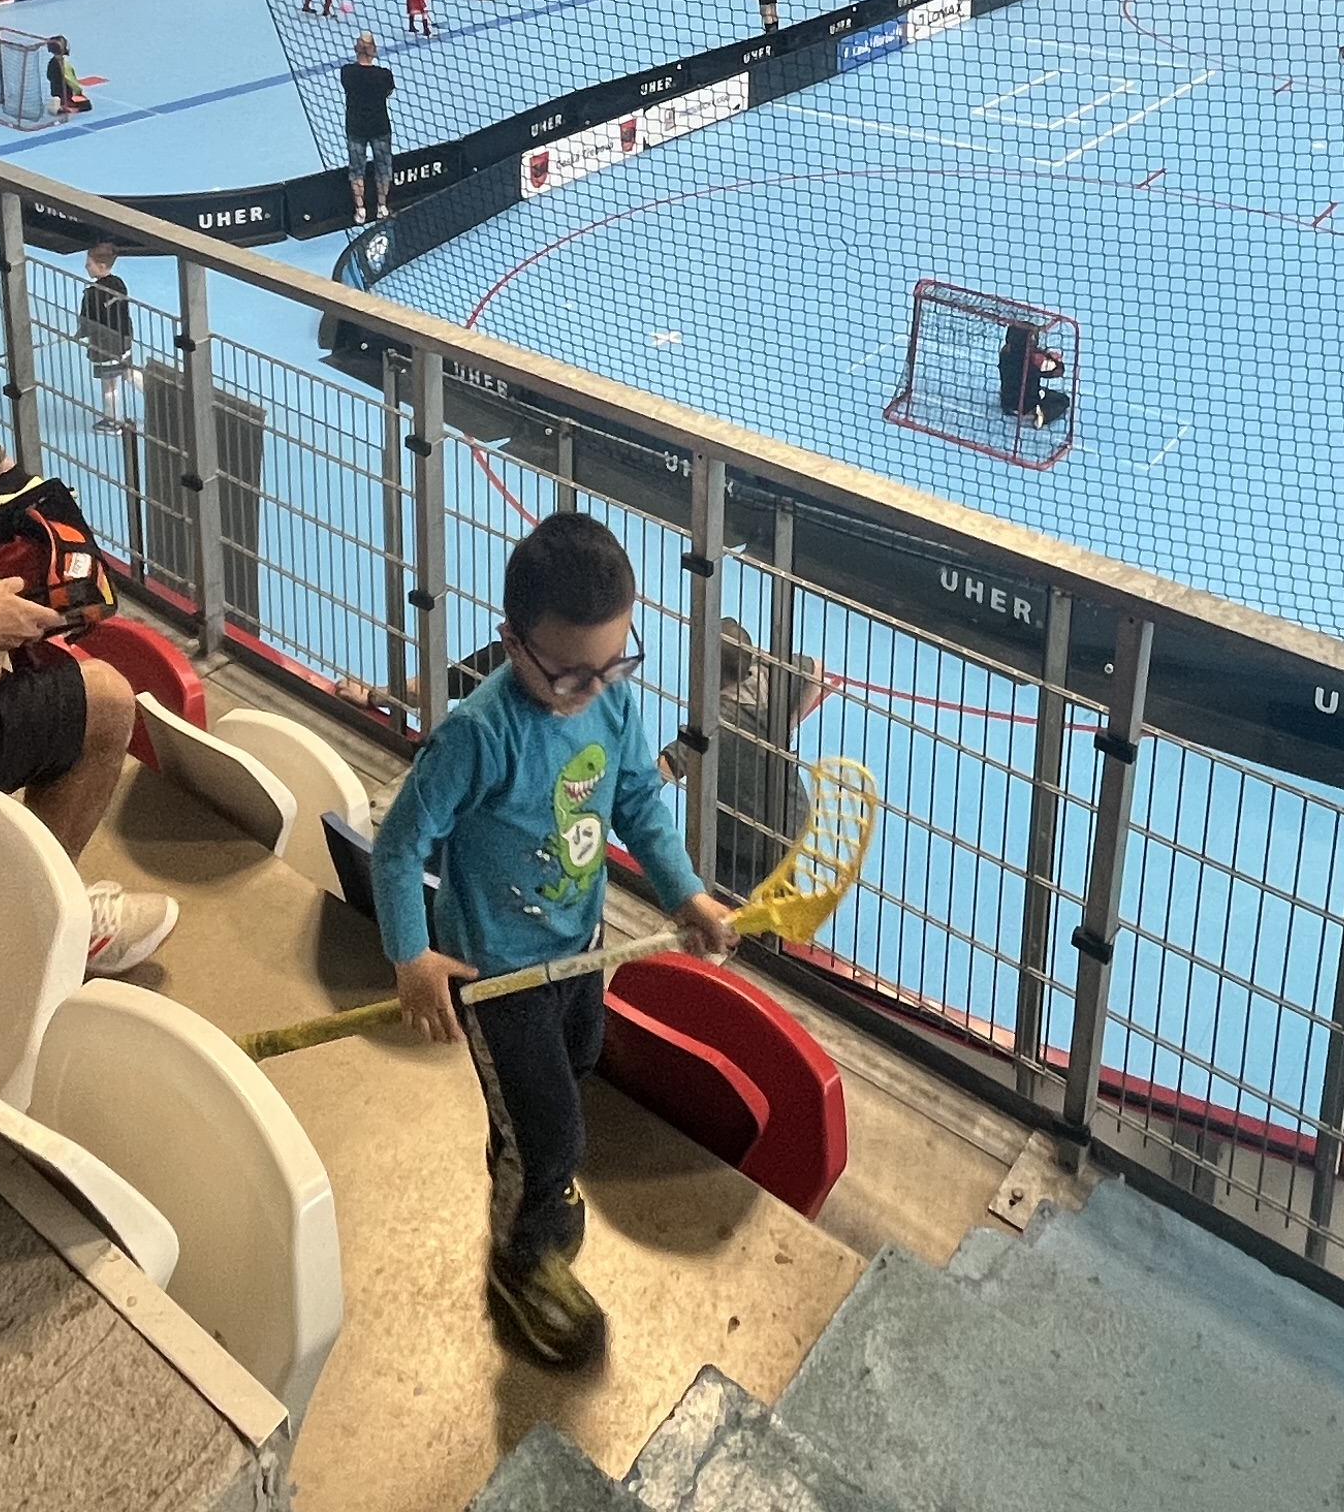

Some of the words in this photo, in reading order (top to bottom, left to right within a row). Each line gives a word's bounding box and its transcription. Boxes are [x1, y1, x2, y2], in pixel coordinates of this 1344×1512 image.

[640, 76, 673, 96] UHER
[530, 113, 563, 138] UHER
[392, 161, 442, 186] UHER
[198, 206, 264, 229] UHER
[939, 568, 1033, 626] UHER
